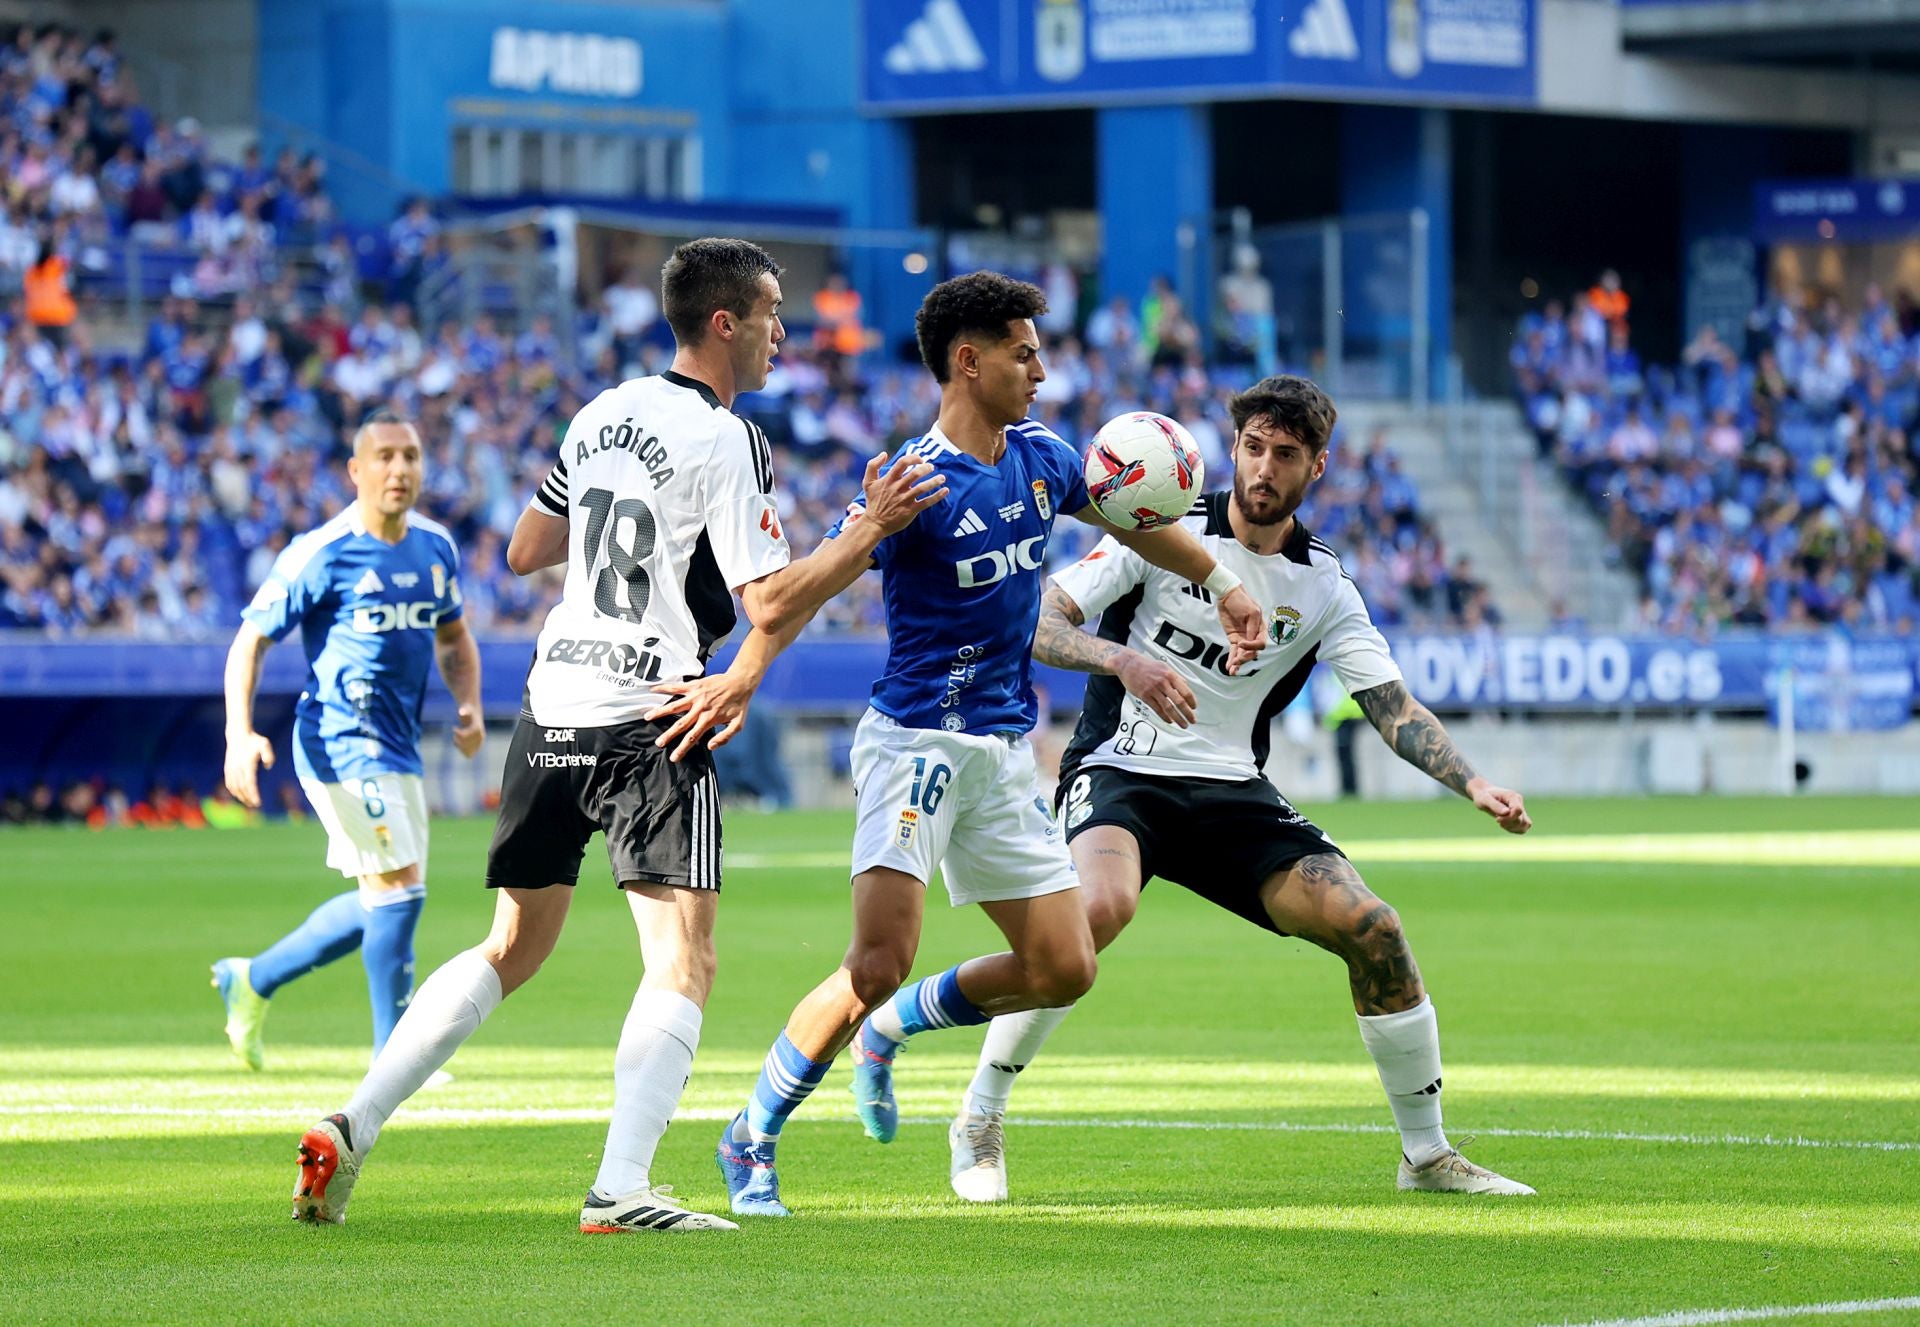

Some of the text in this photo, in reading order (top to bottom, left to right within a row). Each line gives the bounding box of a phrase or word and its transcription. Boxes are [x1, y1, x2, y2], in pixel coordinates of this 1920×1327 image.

[577, 417, 675, 491] A.CÓROBA
[578, 487, 656, 625] 18
[545, 637, 663, 682] BEROIL
[1394, 635, 1723, 702] OVEDO.es
[543, 728, 577, 743] EXDE
[908, 756, 952, 816] 16
